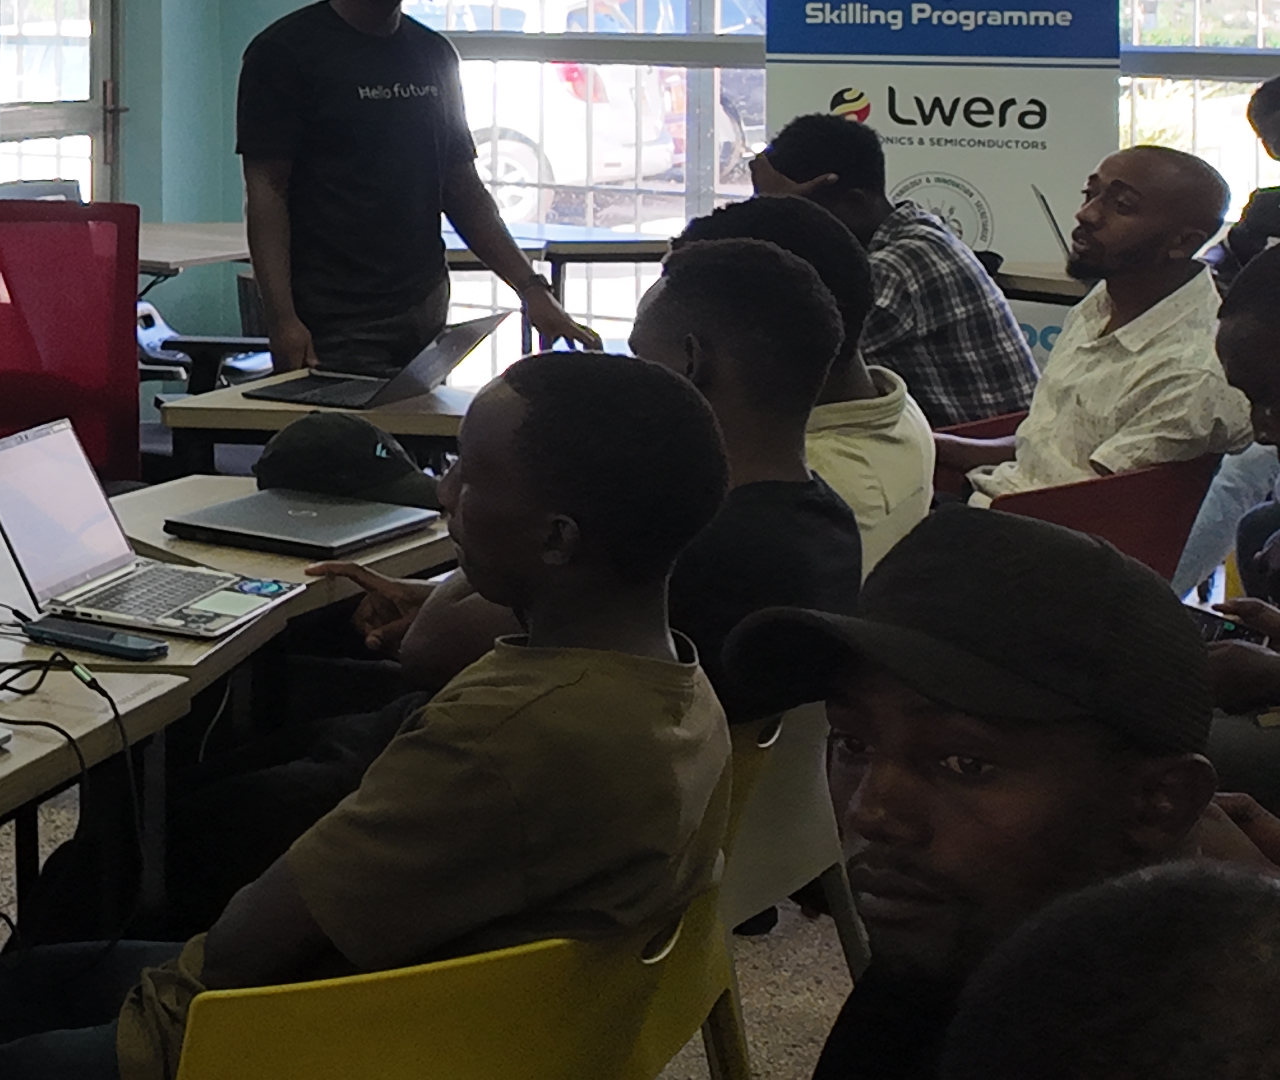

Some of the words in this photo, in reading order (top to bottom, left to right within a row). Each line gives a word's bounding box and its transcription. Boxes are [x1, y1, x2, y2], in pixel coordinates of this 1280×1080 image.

[805, 3, 904, 31] Skilling
[911, 3, 1073, 32] Programme
[358, 85, 391, 100] Hello
[393, 83, 438, 98] future
[887, 85, 1049, 130] Lwera
[879, 136, 915, 147] ONICS
[917, 137, 926, 147] &
[929, 137, 1048, 151] SEMICONDUCTORS
